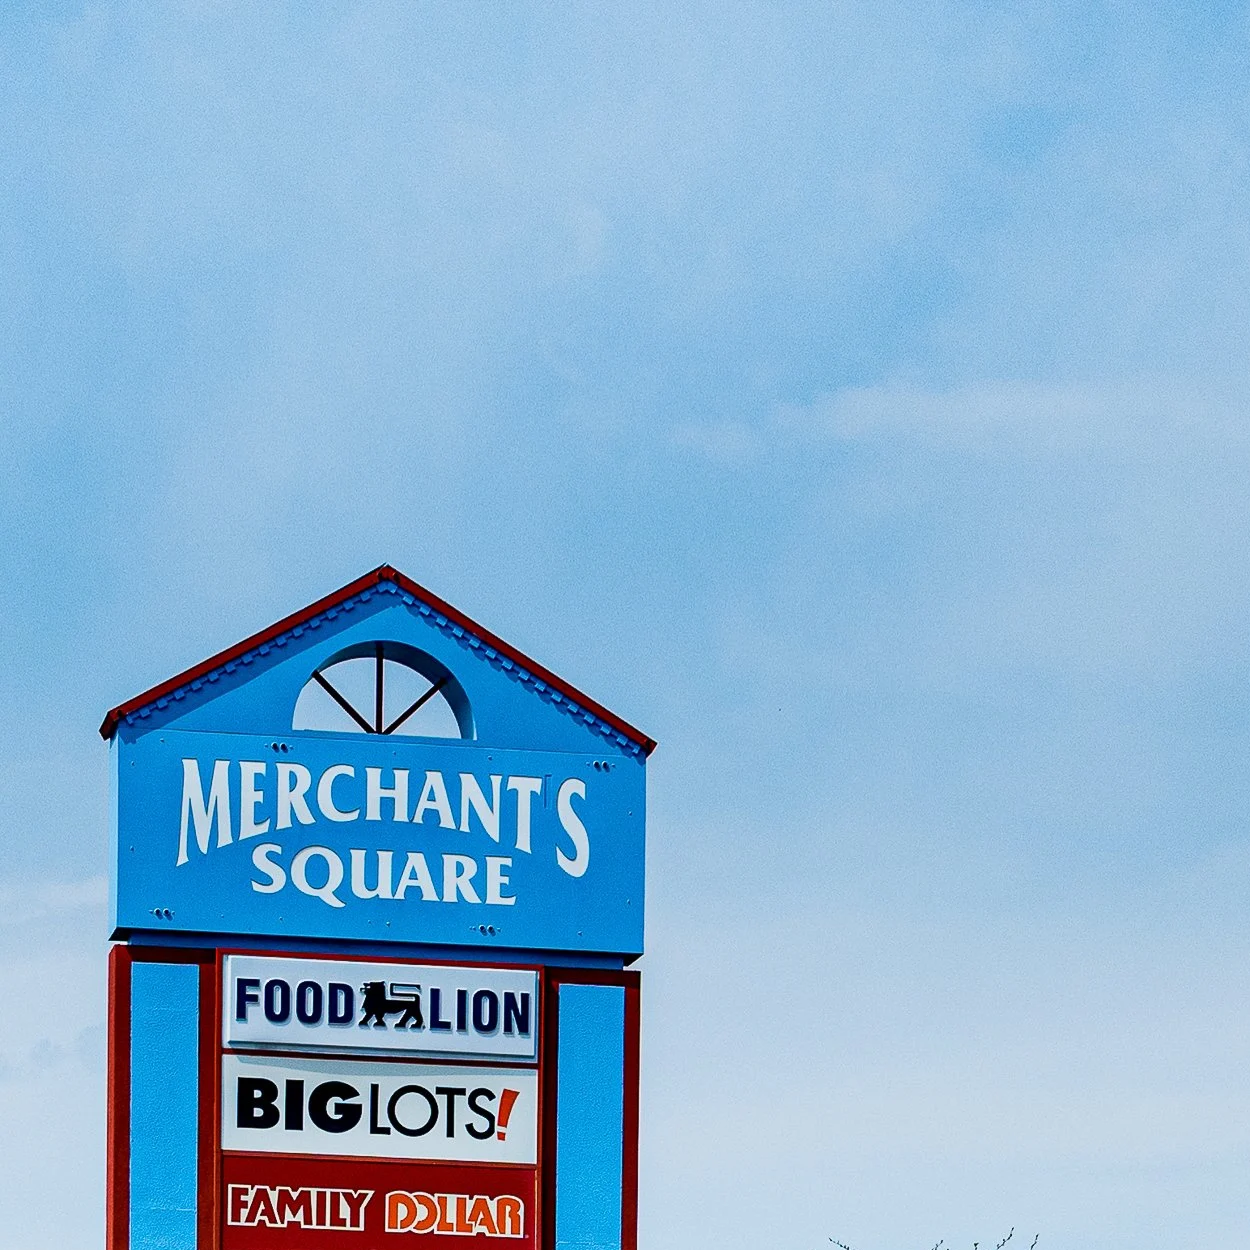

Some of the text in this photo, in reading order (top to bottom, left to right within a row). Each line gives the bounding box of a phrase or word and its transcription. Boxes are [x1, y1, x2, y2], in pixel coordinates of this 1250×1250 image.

[251, 841, 517, 907] SQUARE
[235, 977, 530, 1037] FOOD LION
[227, 1184, 524, 1239] FAMILY DOLLAR
